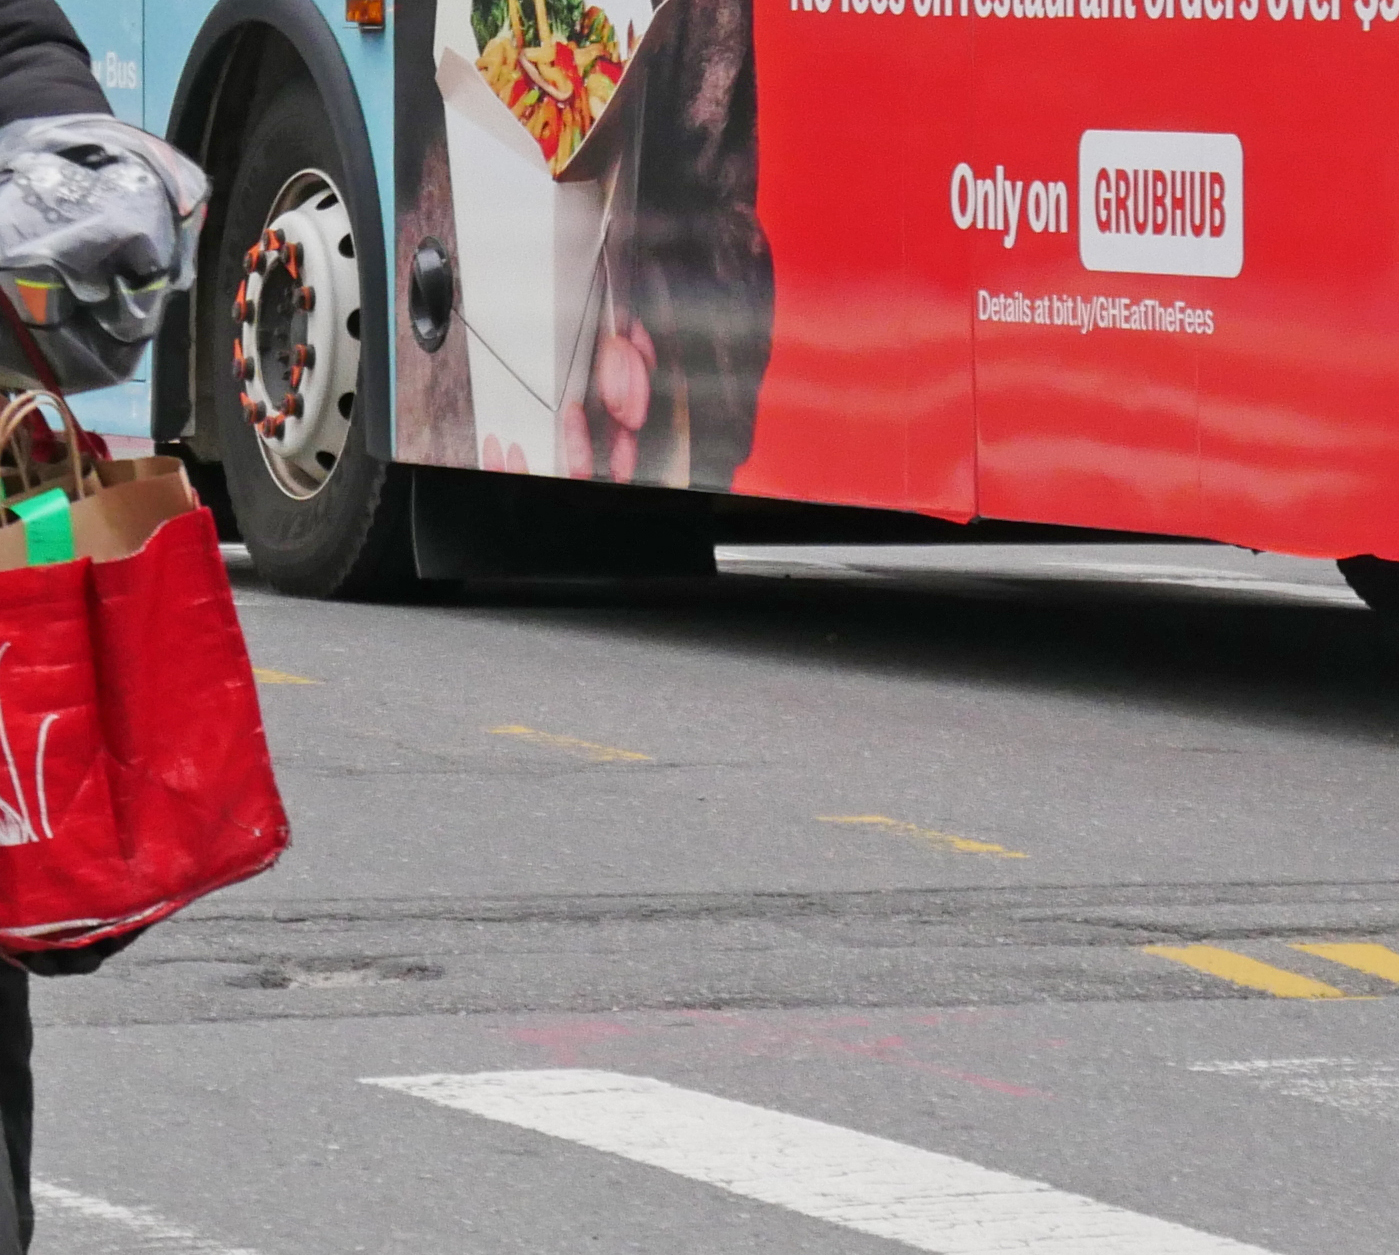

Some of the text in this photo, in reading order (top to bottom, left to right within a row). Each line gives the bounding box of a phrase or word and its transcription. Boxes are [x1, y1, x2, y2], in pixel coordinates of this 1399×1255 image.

[106, 51, 137, 89] Bus
[950, 162, 1227, 249] Only on GRUBHUB
[978, 289, 1215, 335] Details at bit.ly/GHEatTheFees
